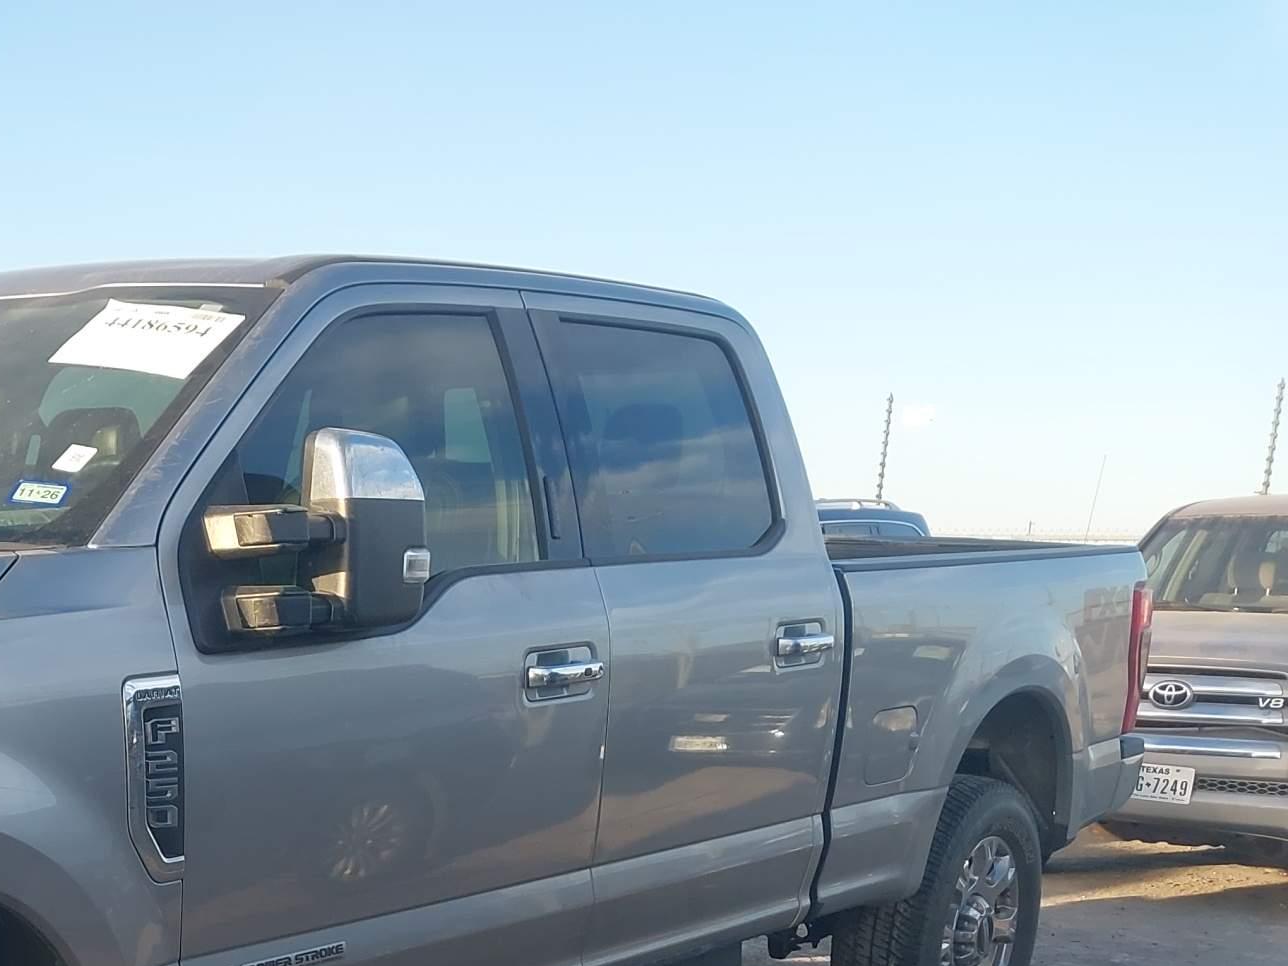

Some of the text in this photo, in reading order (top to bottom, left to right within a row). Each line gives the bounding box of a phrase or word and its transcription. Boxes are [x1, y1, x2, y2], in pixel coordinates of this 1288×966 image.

[104, 316, 213, 338] 44186594
[136, 684, 181, 701] LARIAT
[1258, 697, 1285, 708] V8
[1141, 765, 1171, 776] TEXAS
[295, 943, 344, 965] STROKE
